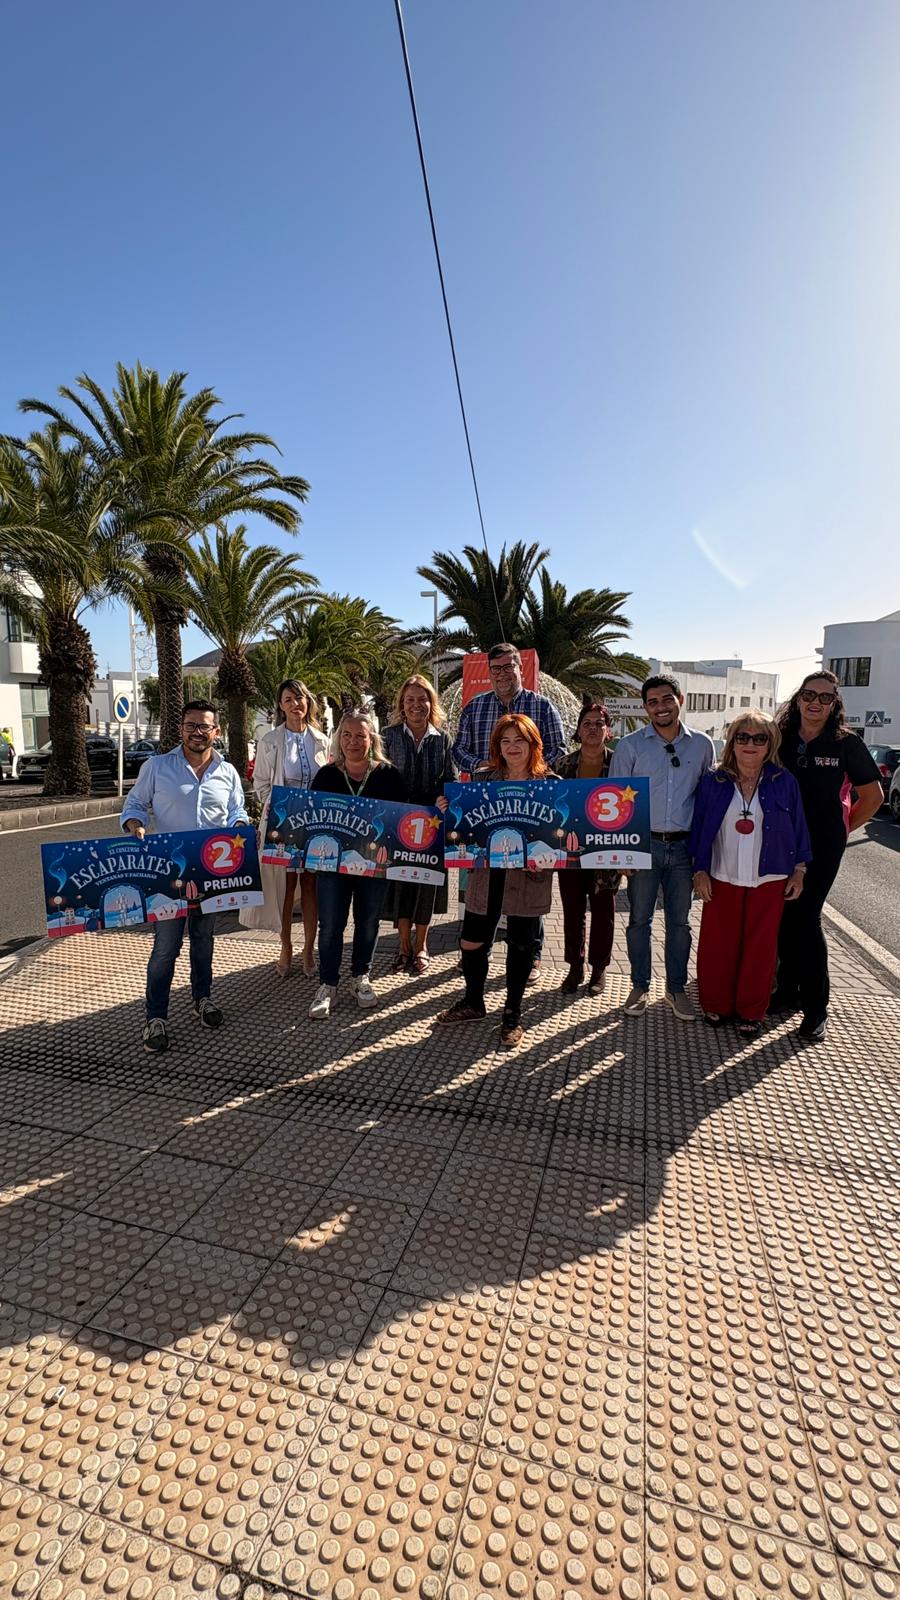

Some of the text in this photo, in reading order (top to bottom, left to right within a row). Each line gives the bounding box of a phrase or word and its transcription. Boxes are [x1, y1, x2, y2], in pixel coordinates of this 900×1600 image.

[463, 799, 557, 828] ESCAPARATES
[597, 791, 620, 822] 3
[287, 808, 374, 837] ESCAPARATES
[410, 817, 425, 844] 1
[585, 833, 641, 845] PREMIO
[211, 840, 234, 869] 2
[393, 850, 439, 865] PREMIO
[69, 854, 174, 889] ESCAPARATES
[203, 875, 253, 892] PREMIO
